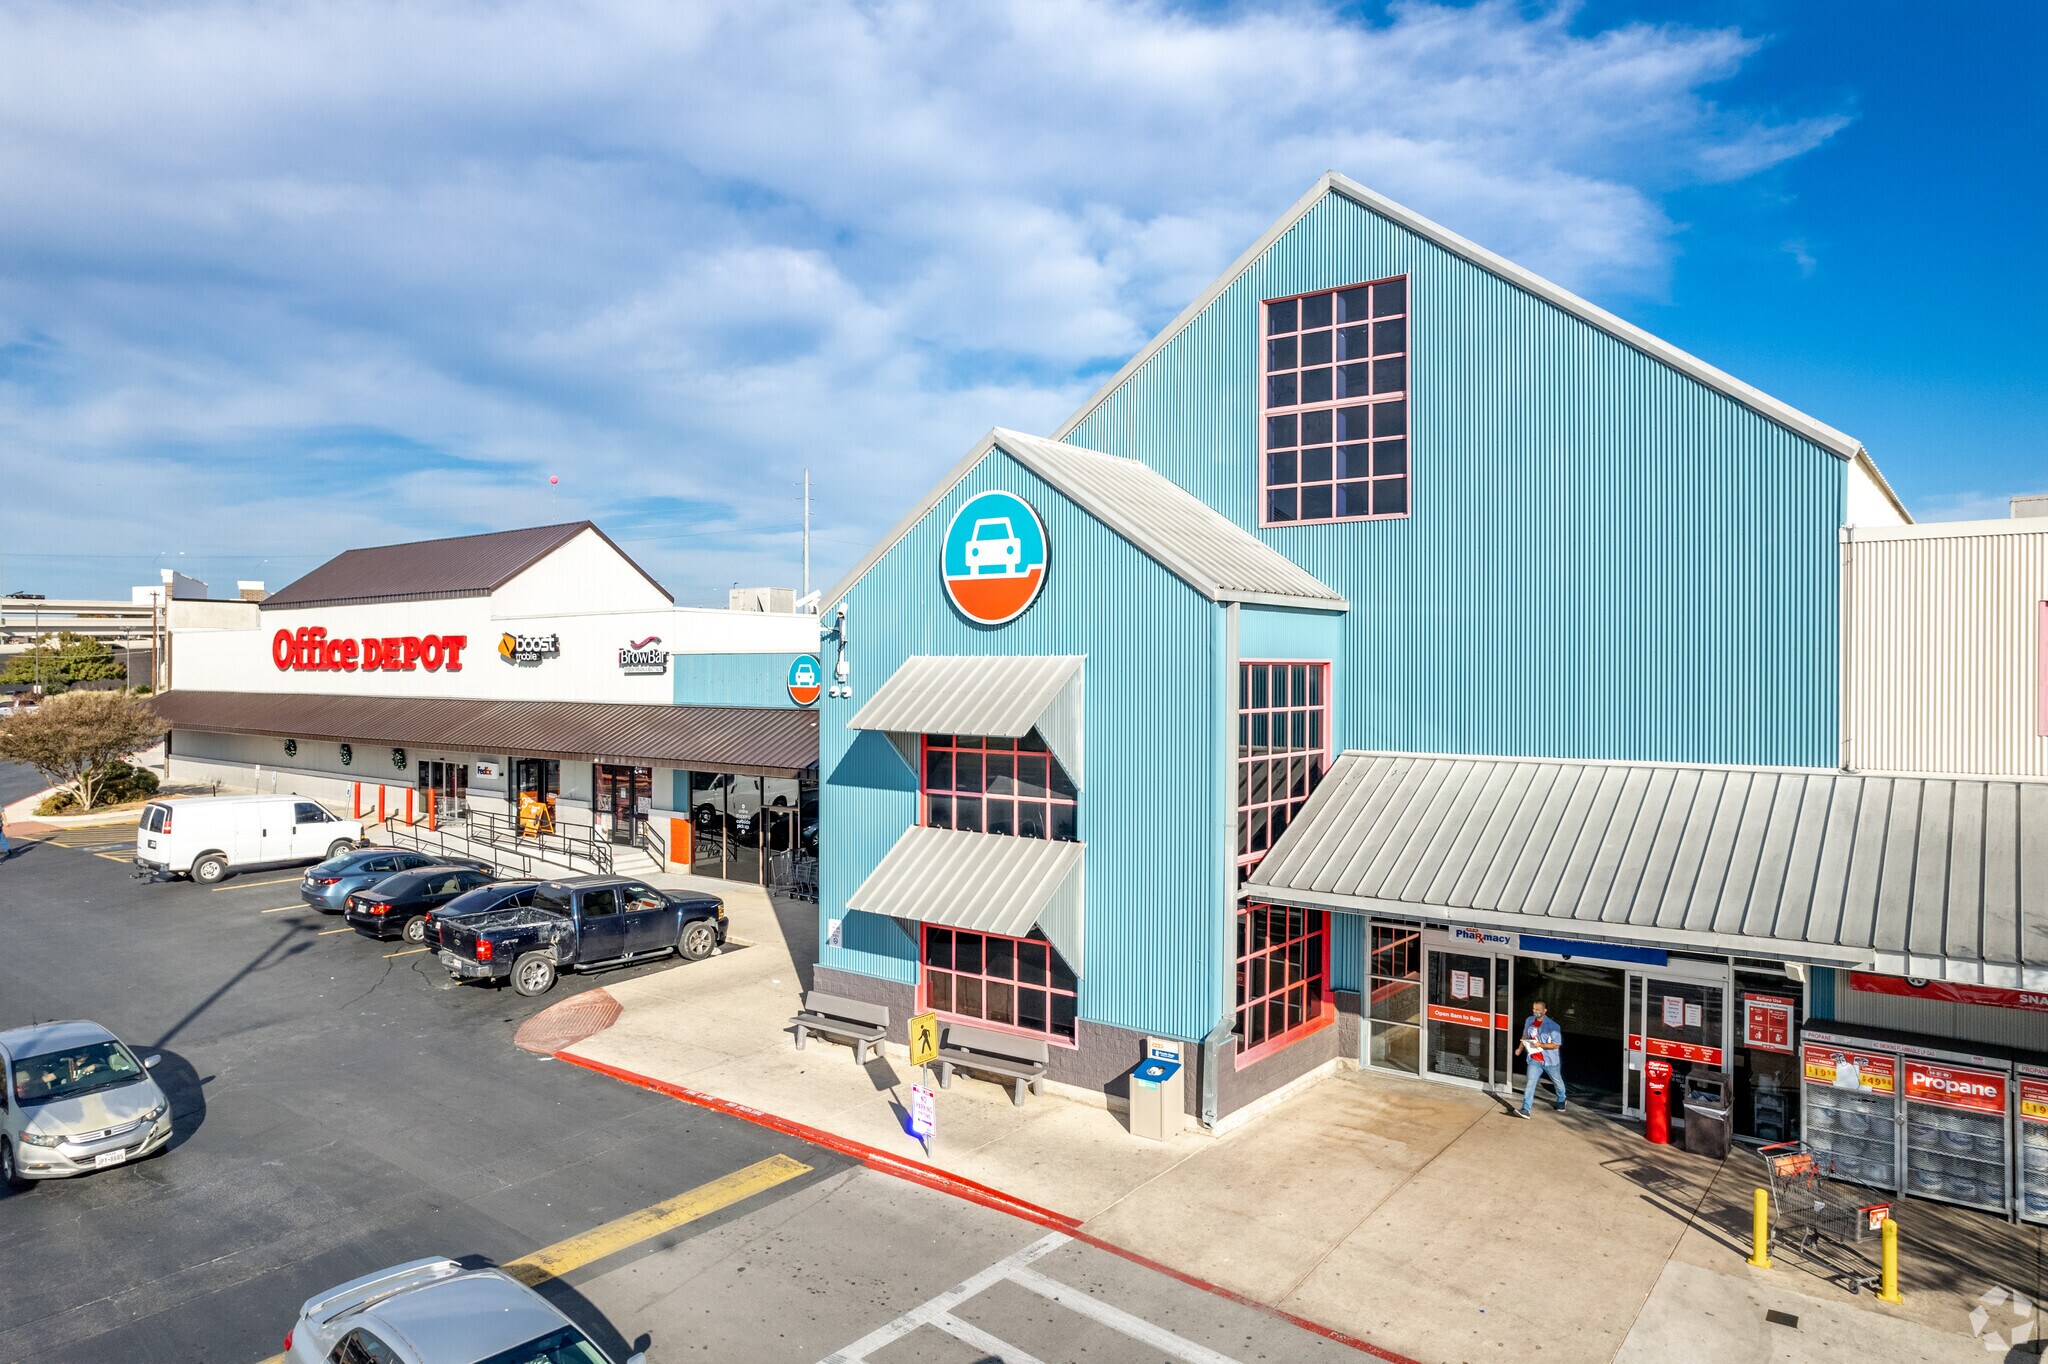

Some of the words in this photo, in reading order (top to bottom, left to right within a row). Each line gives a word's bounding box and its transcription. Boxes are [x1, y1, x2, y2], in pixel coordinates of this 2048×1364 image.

[515, 635, 555, 652] boost
[272, 626, 359, 672] Office
[361, 634, 467, 672] DEPOT
[515, 652, 538, 661] mobile
[477, 766, 493, 776] FedEx
[1434, 1010, 1449, 1018] Open
[1808, 1032, 1831, 1041] PROPANE
[1897, 1045, 1920, 1054] FLAMMABLE
[1912, 1071, 1998, 1098] Propane
